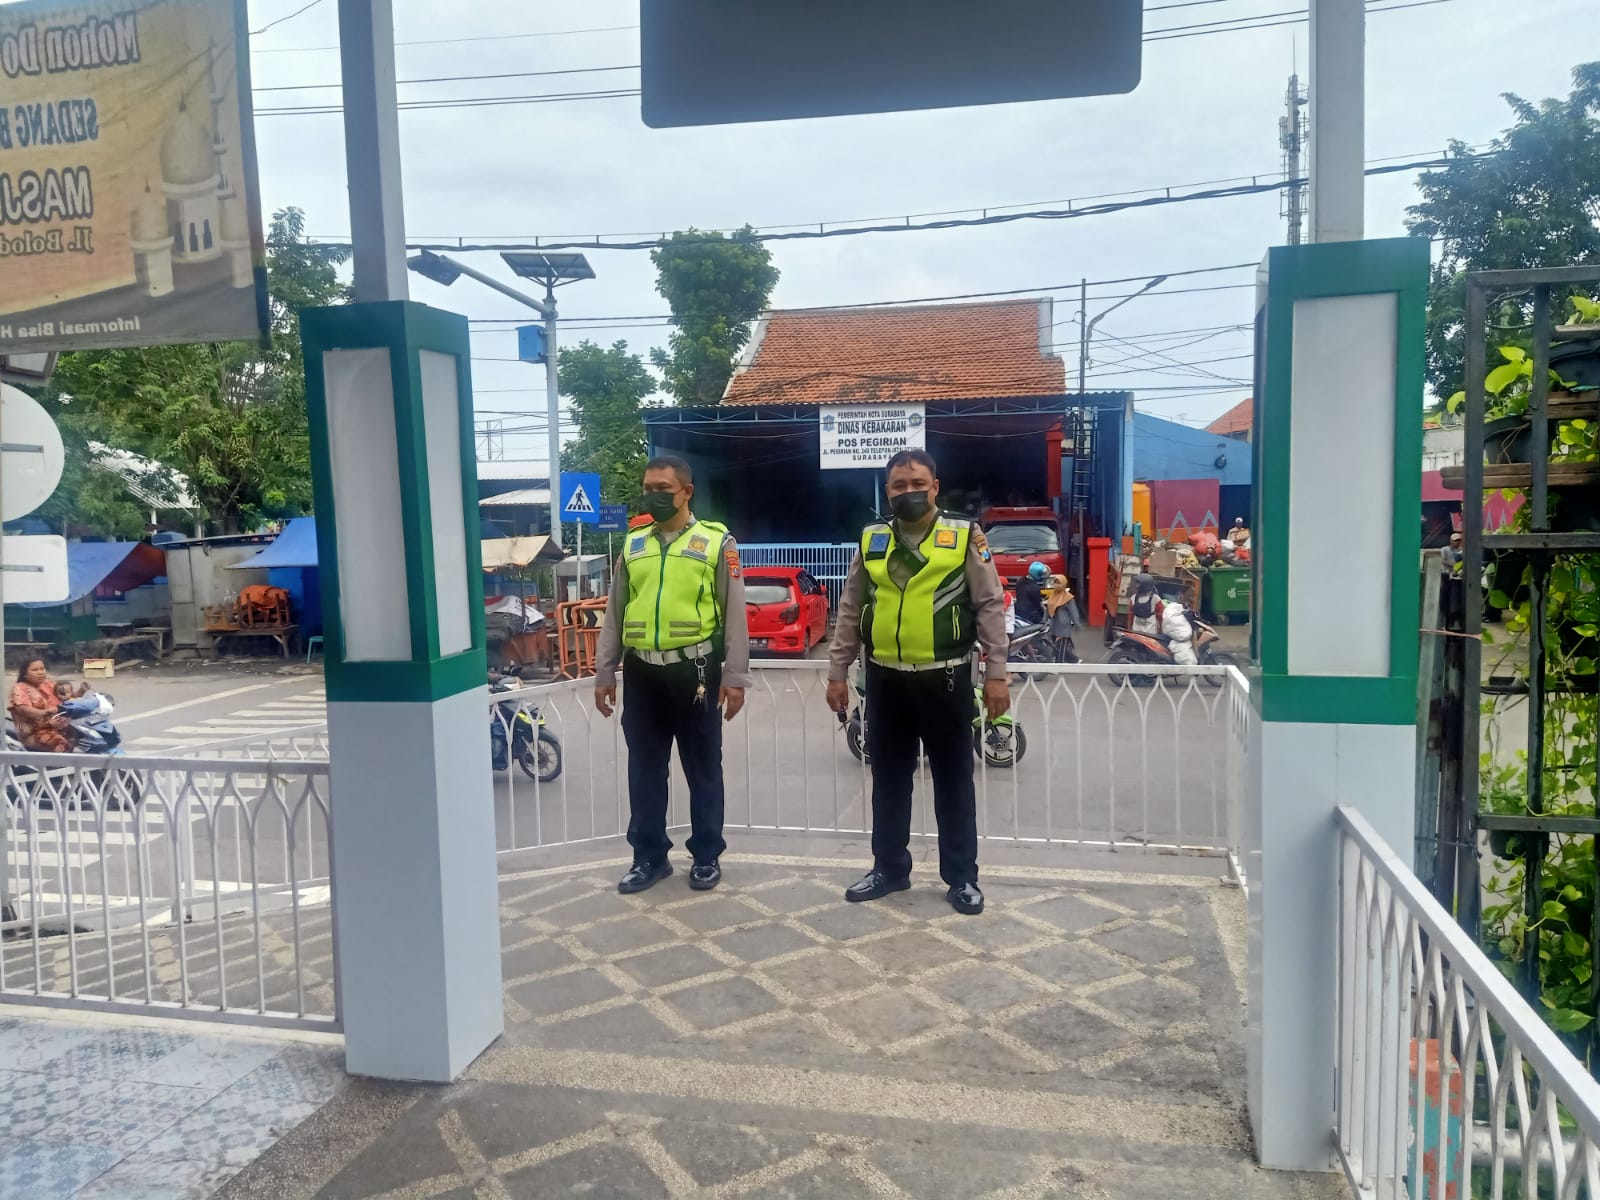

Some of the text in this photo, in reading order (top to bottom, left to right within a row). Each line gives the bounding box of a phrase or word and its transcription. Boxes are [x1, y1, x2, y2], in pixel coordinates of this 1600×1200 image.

[838, 410, 906, 419] PEMERINTAH KOTA SURABAYA
[838, 420, 907, 434] DINAS KEBAKARAN
[838, 437, 907, 447] POS PEGIRIAN
